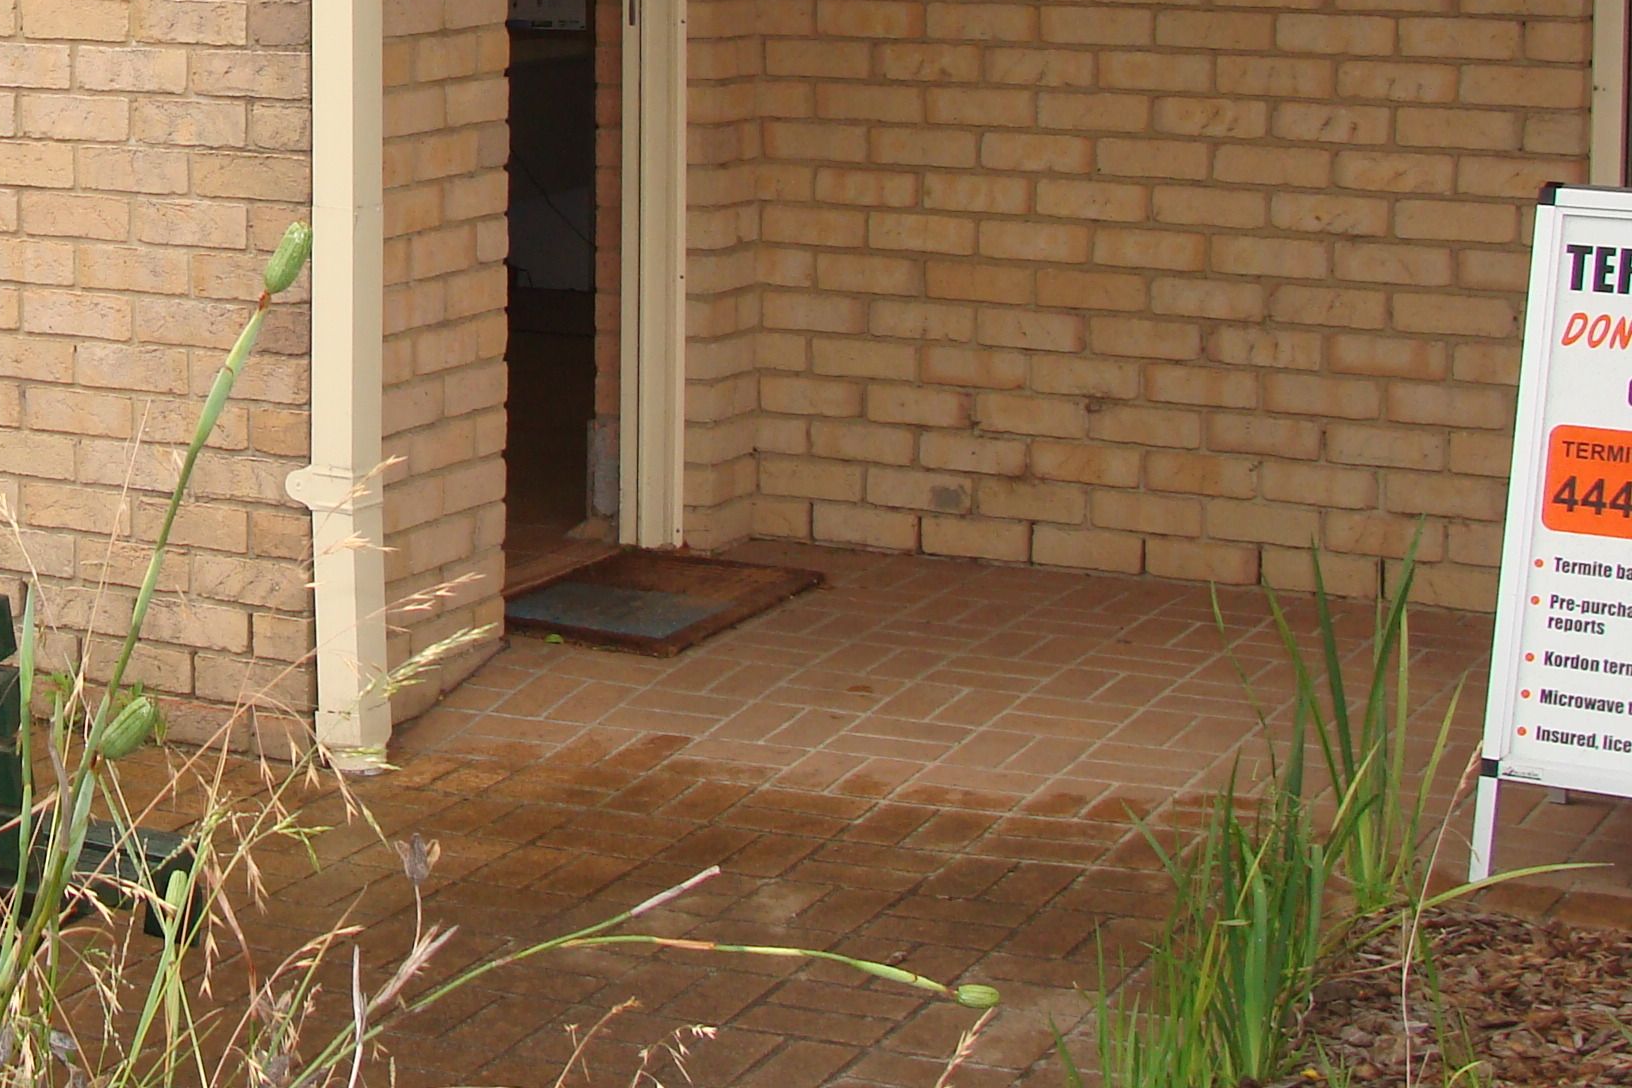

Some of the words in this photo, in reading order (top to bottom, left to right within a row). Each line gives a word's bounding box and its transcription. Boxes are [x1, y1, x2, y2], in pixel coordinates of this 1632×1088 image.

[1552, 474, 1632, 519] 444
[1554, 557, 1612, 579] Termite
[1547, 616, 1605, 635] reports
[1543, 650, 1600, 673] Kordon
[1539, 688, 1624, 714] Microwave
[1536, 726, 1599, 750] Insured,
[1602, 734, 1632, 753] lice
